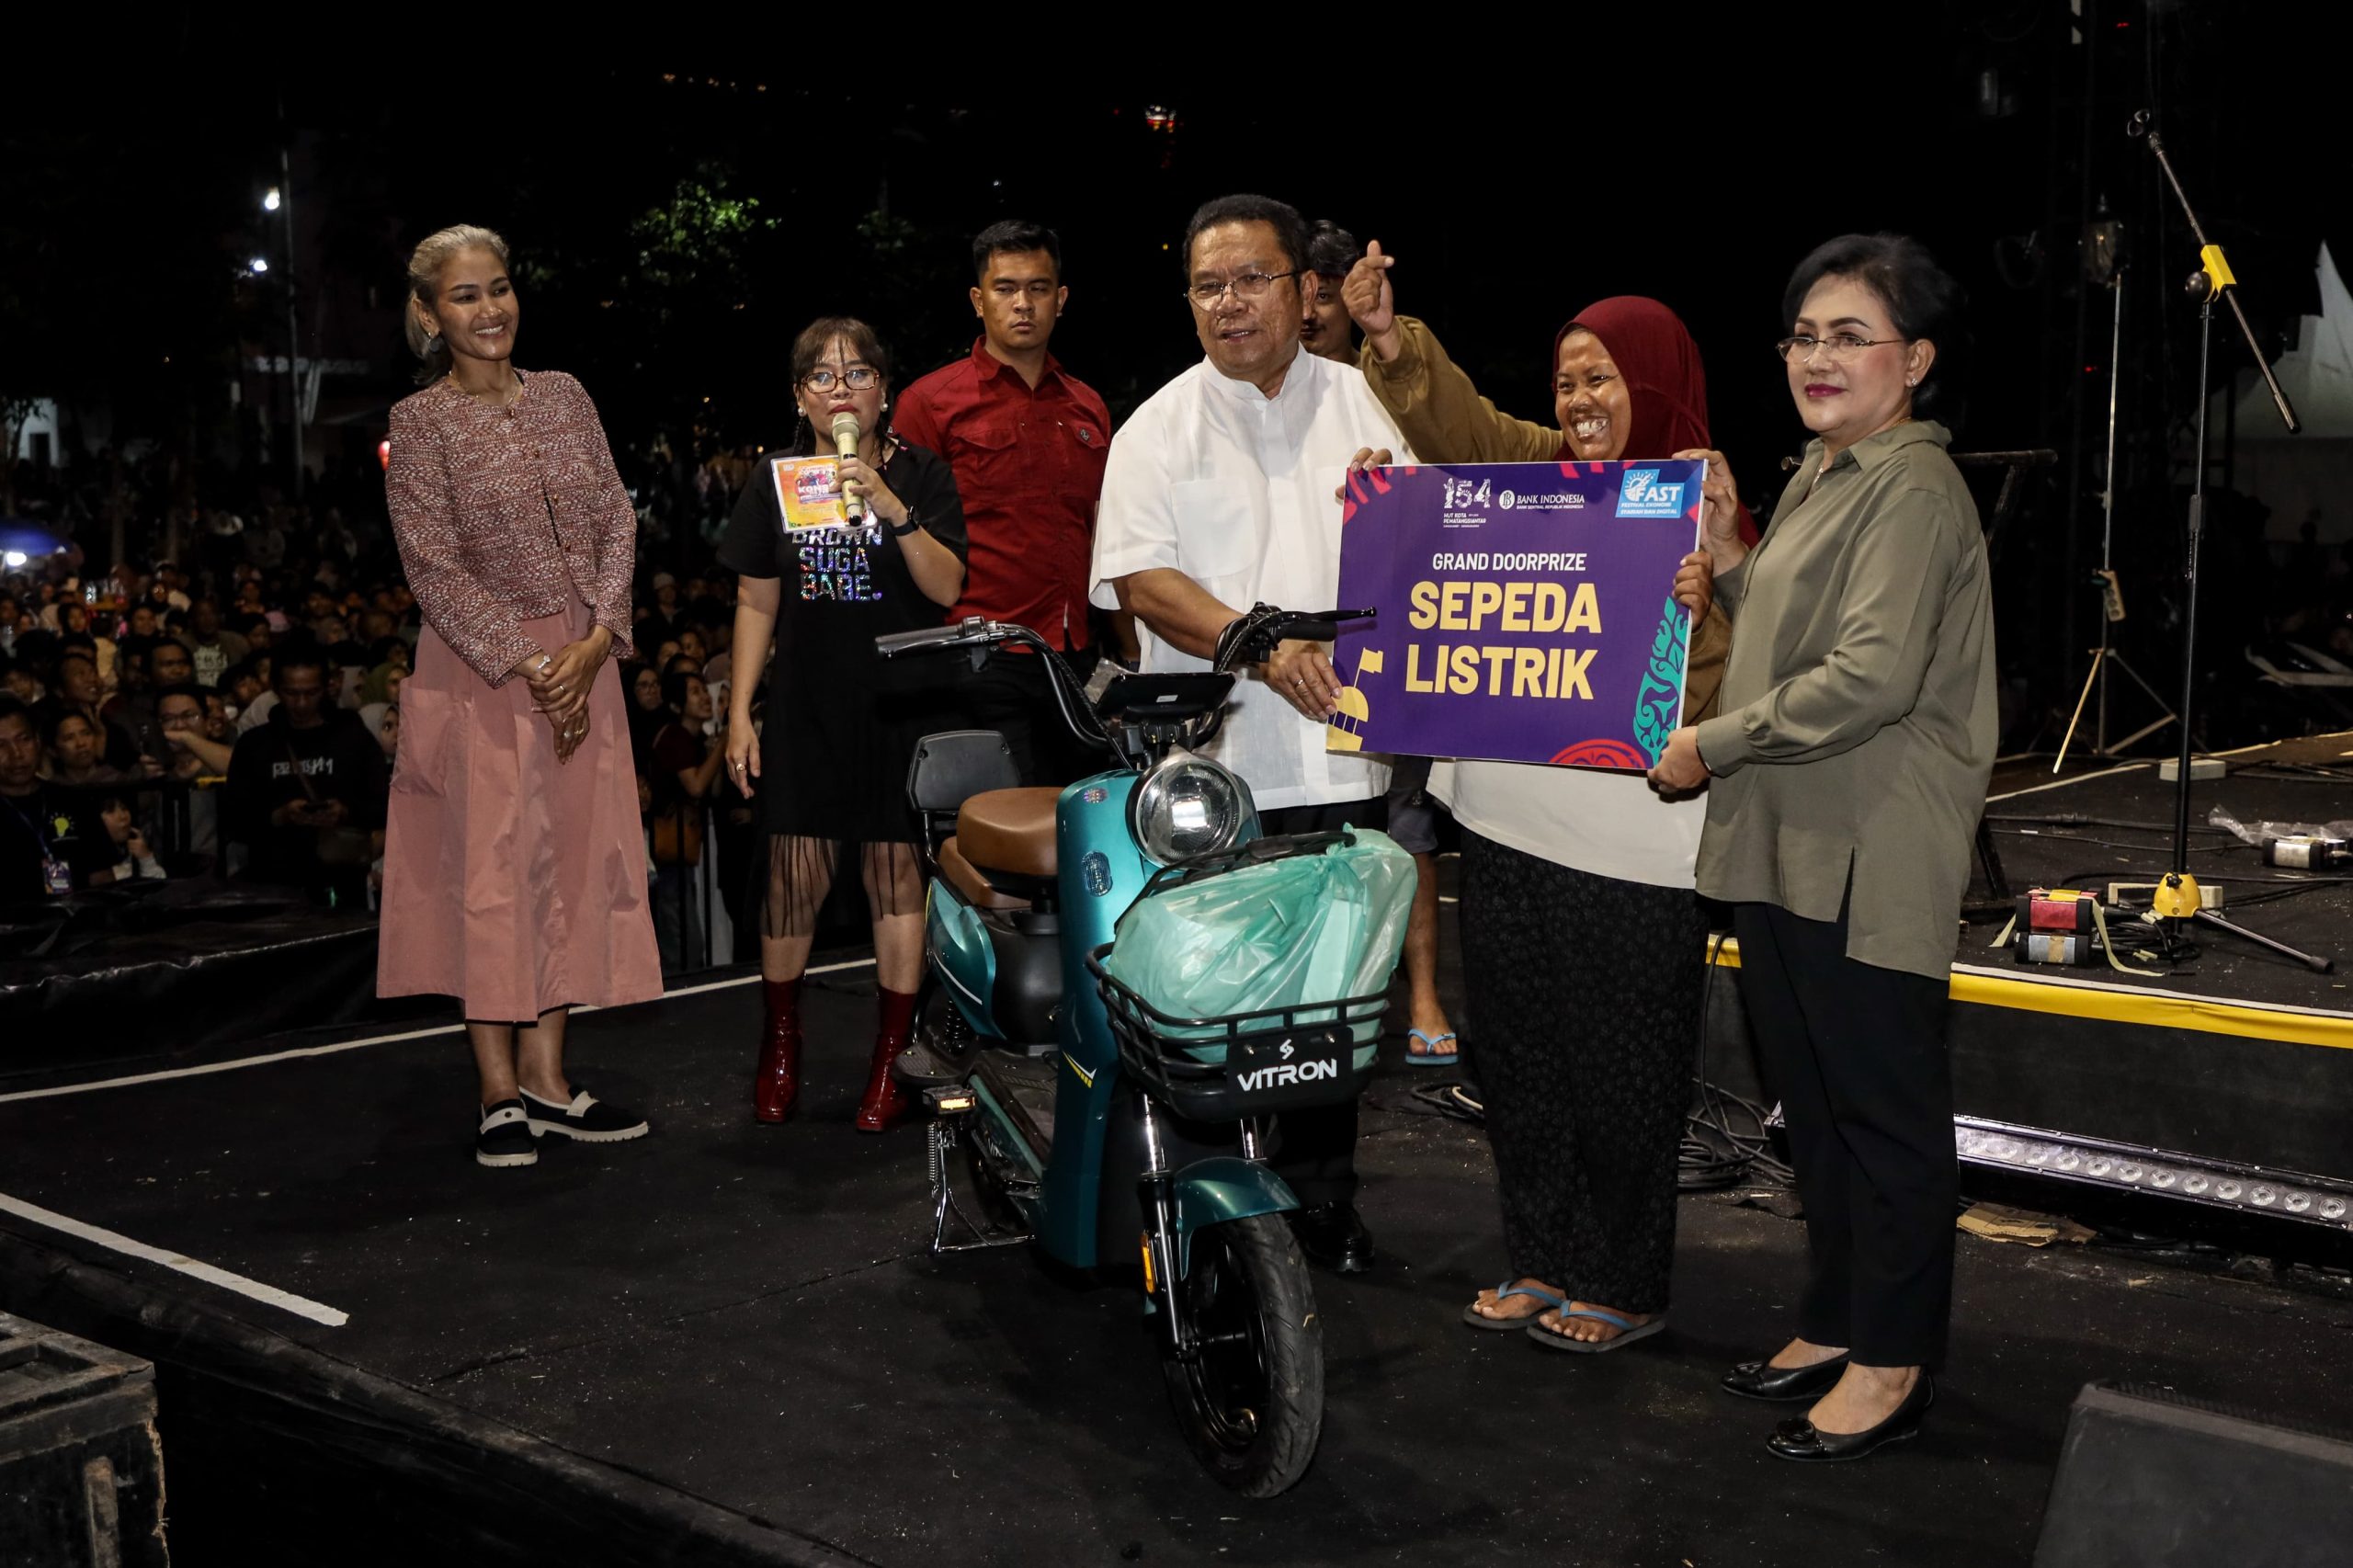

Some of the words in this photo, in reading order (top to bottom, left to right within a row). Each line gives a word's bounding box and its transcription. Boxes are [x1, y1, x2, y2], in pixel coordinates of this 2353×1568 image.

[1444, 478, 1491, 508] 154
[1517, 494, 1538, 505] BANK
[1540, 494, 1585, 505] INDONESIA
[1635, 486, 1681, 502] FAST
[799, 547, 870, 573] SUGA
[1432, 552, 1489, 571] GRAND
[1492, 552, 1587, 572] DOORPRIZE
[1408, 580, 1602, 634] SEPEDA
[1405, 643, 1598, 700] LISTRIK
[1237, 1058, 1337, 1092] VITRON
